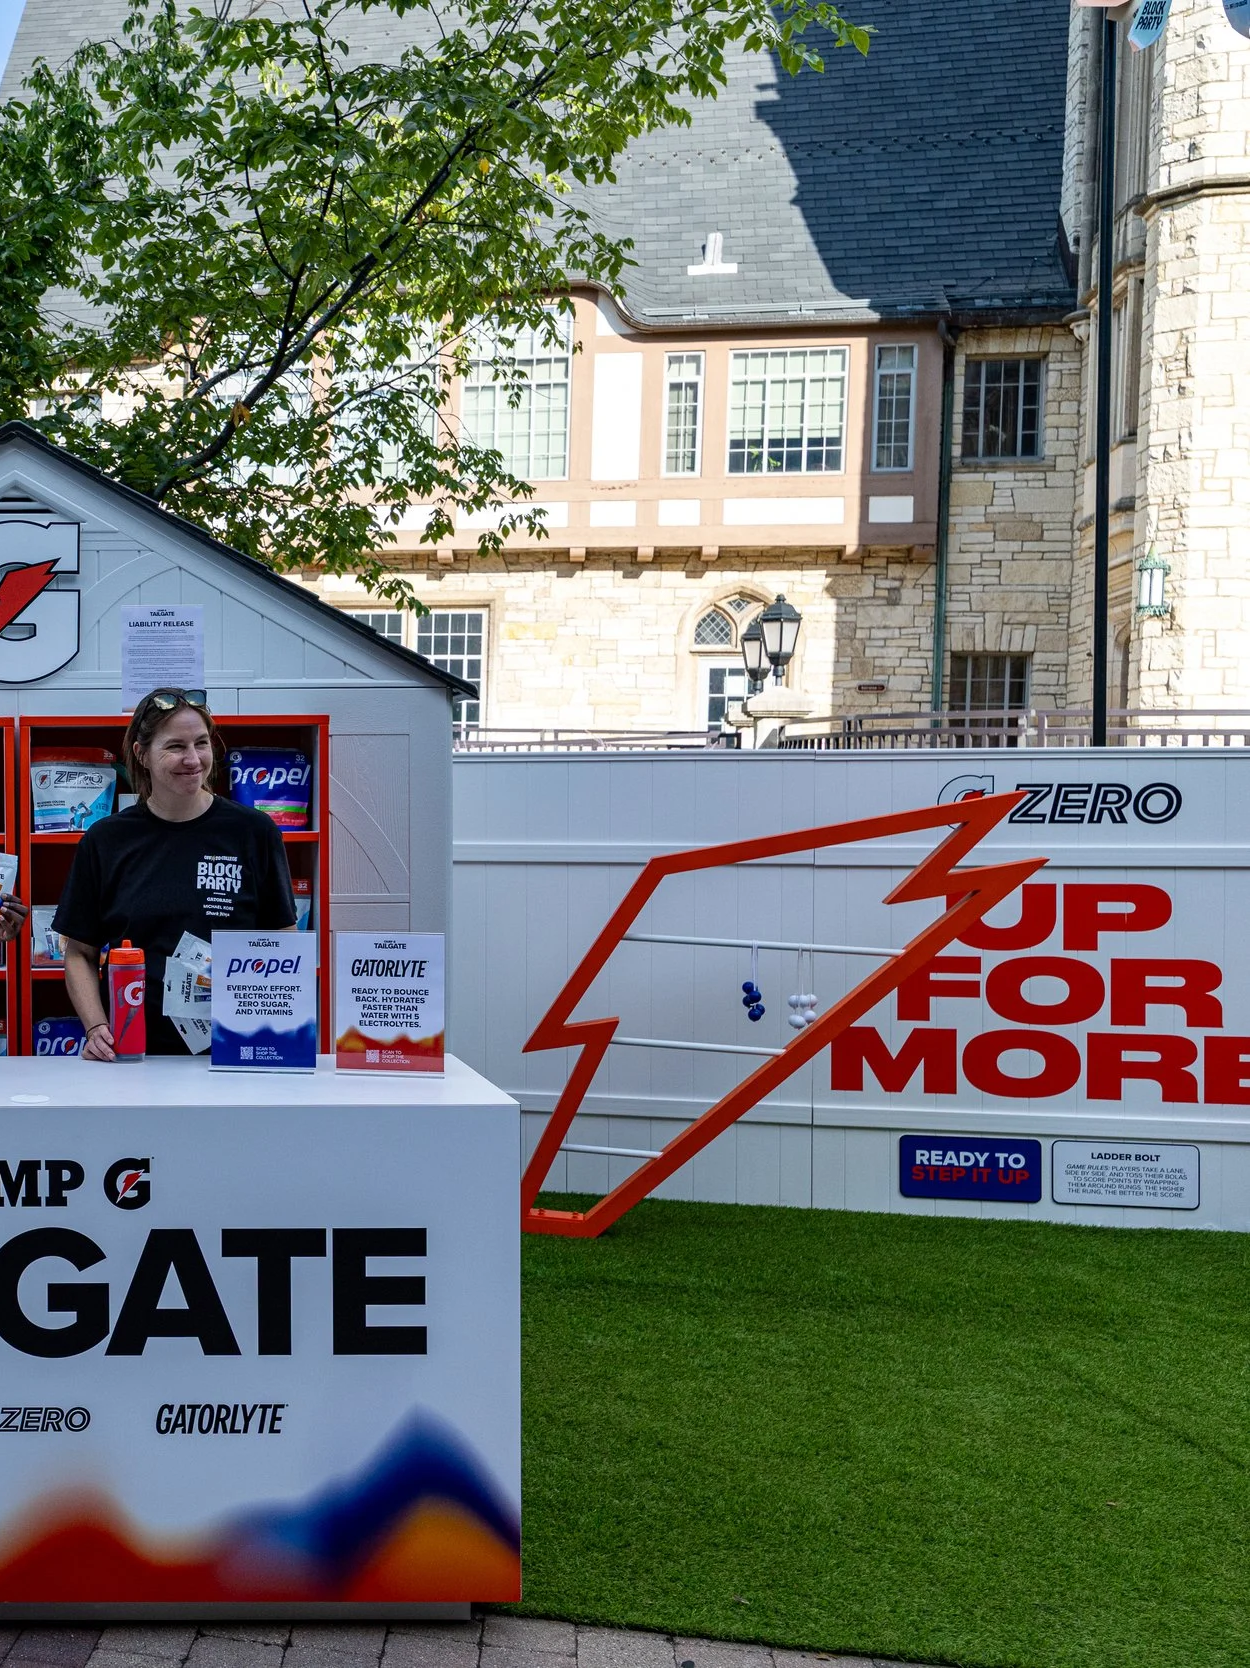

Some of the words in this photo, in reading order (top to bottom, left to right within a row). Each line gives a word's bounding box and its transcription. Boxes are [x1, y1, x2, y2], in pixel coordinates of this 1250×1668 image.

[1141, 0, 1167, 15] BLOCK
[1135, 15, 1164, 30] PARTY
[163, 620, 194, 628] RELEASE
[295, 754, 306, 762] 32
[53, 770, 103, 786] ZERO
[229, 764, 312, 791] propel
[1007, 781, 1183, 825] ZERO
[197, 861, 243, 880] BLOCK
[196, 876, 242, 894] PARTY
[945, 882, 1173, 951] UP
[374, 942, 407, 950] TAILGATE
[226, 955, 302, 978] propel
[351, 958, 429, 978] GATORLYTE
[184, 972, 193, 1003] TAILGATE
[226, 984, 268, 992] EVERYDAY
[351, 987, 378, 995] READY
[393, 988, 429, 996] BOUNCE
[897, 955, 1224, 1028] FOR
[234, 992, 295, 1001] ELECTROLYTES,
[355, 995, 380, 1003] BACK.
[381, 996, 426, 1004] HYDRATES
[235, 1008, 253, 1016] AND
[237, 1000, 259, 1008] ZERO
[260, 1001, 291, 1009] SUGAR,
[362, 1003, 393, 1011] FASTER
[394, 1004, 418, 1012] THAN
[360, 1011, 389, 1019] WATER
[414, 1012, 420, 1020] 5
[358, 1019, 422, 1028] ELECTROLYTES.
[830, 1026, 1250, 1105] MORE
[914, 1148, 988, 1168] READY
[995, 1152, 1026, 1169] TO
[1090, 1152, 1132, 1162] LADDER
[1134, 1153, 1161, 1162] BOLT
[911, 1165, 967, 1182] STEP
[972, 1167, 991, 1183] IT
[997, 1168, 1031, 1185] UP
[103, 1156, 152, 1211] G
[155, 1403, 290, 1435] GATORLYTE
